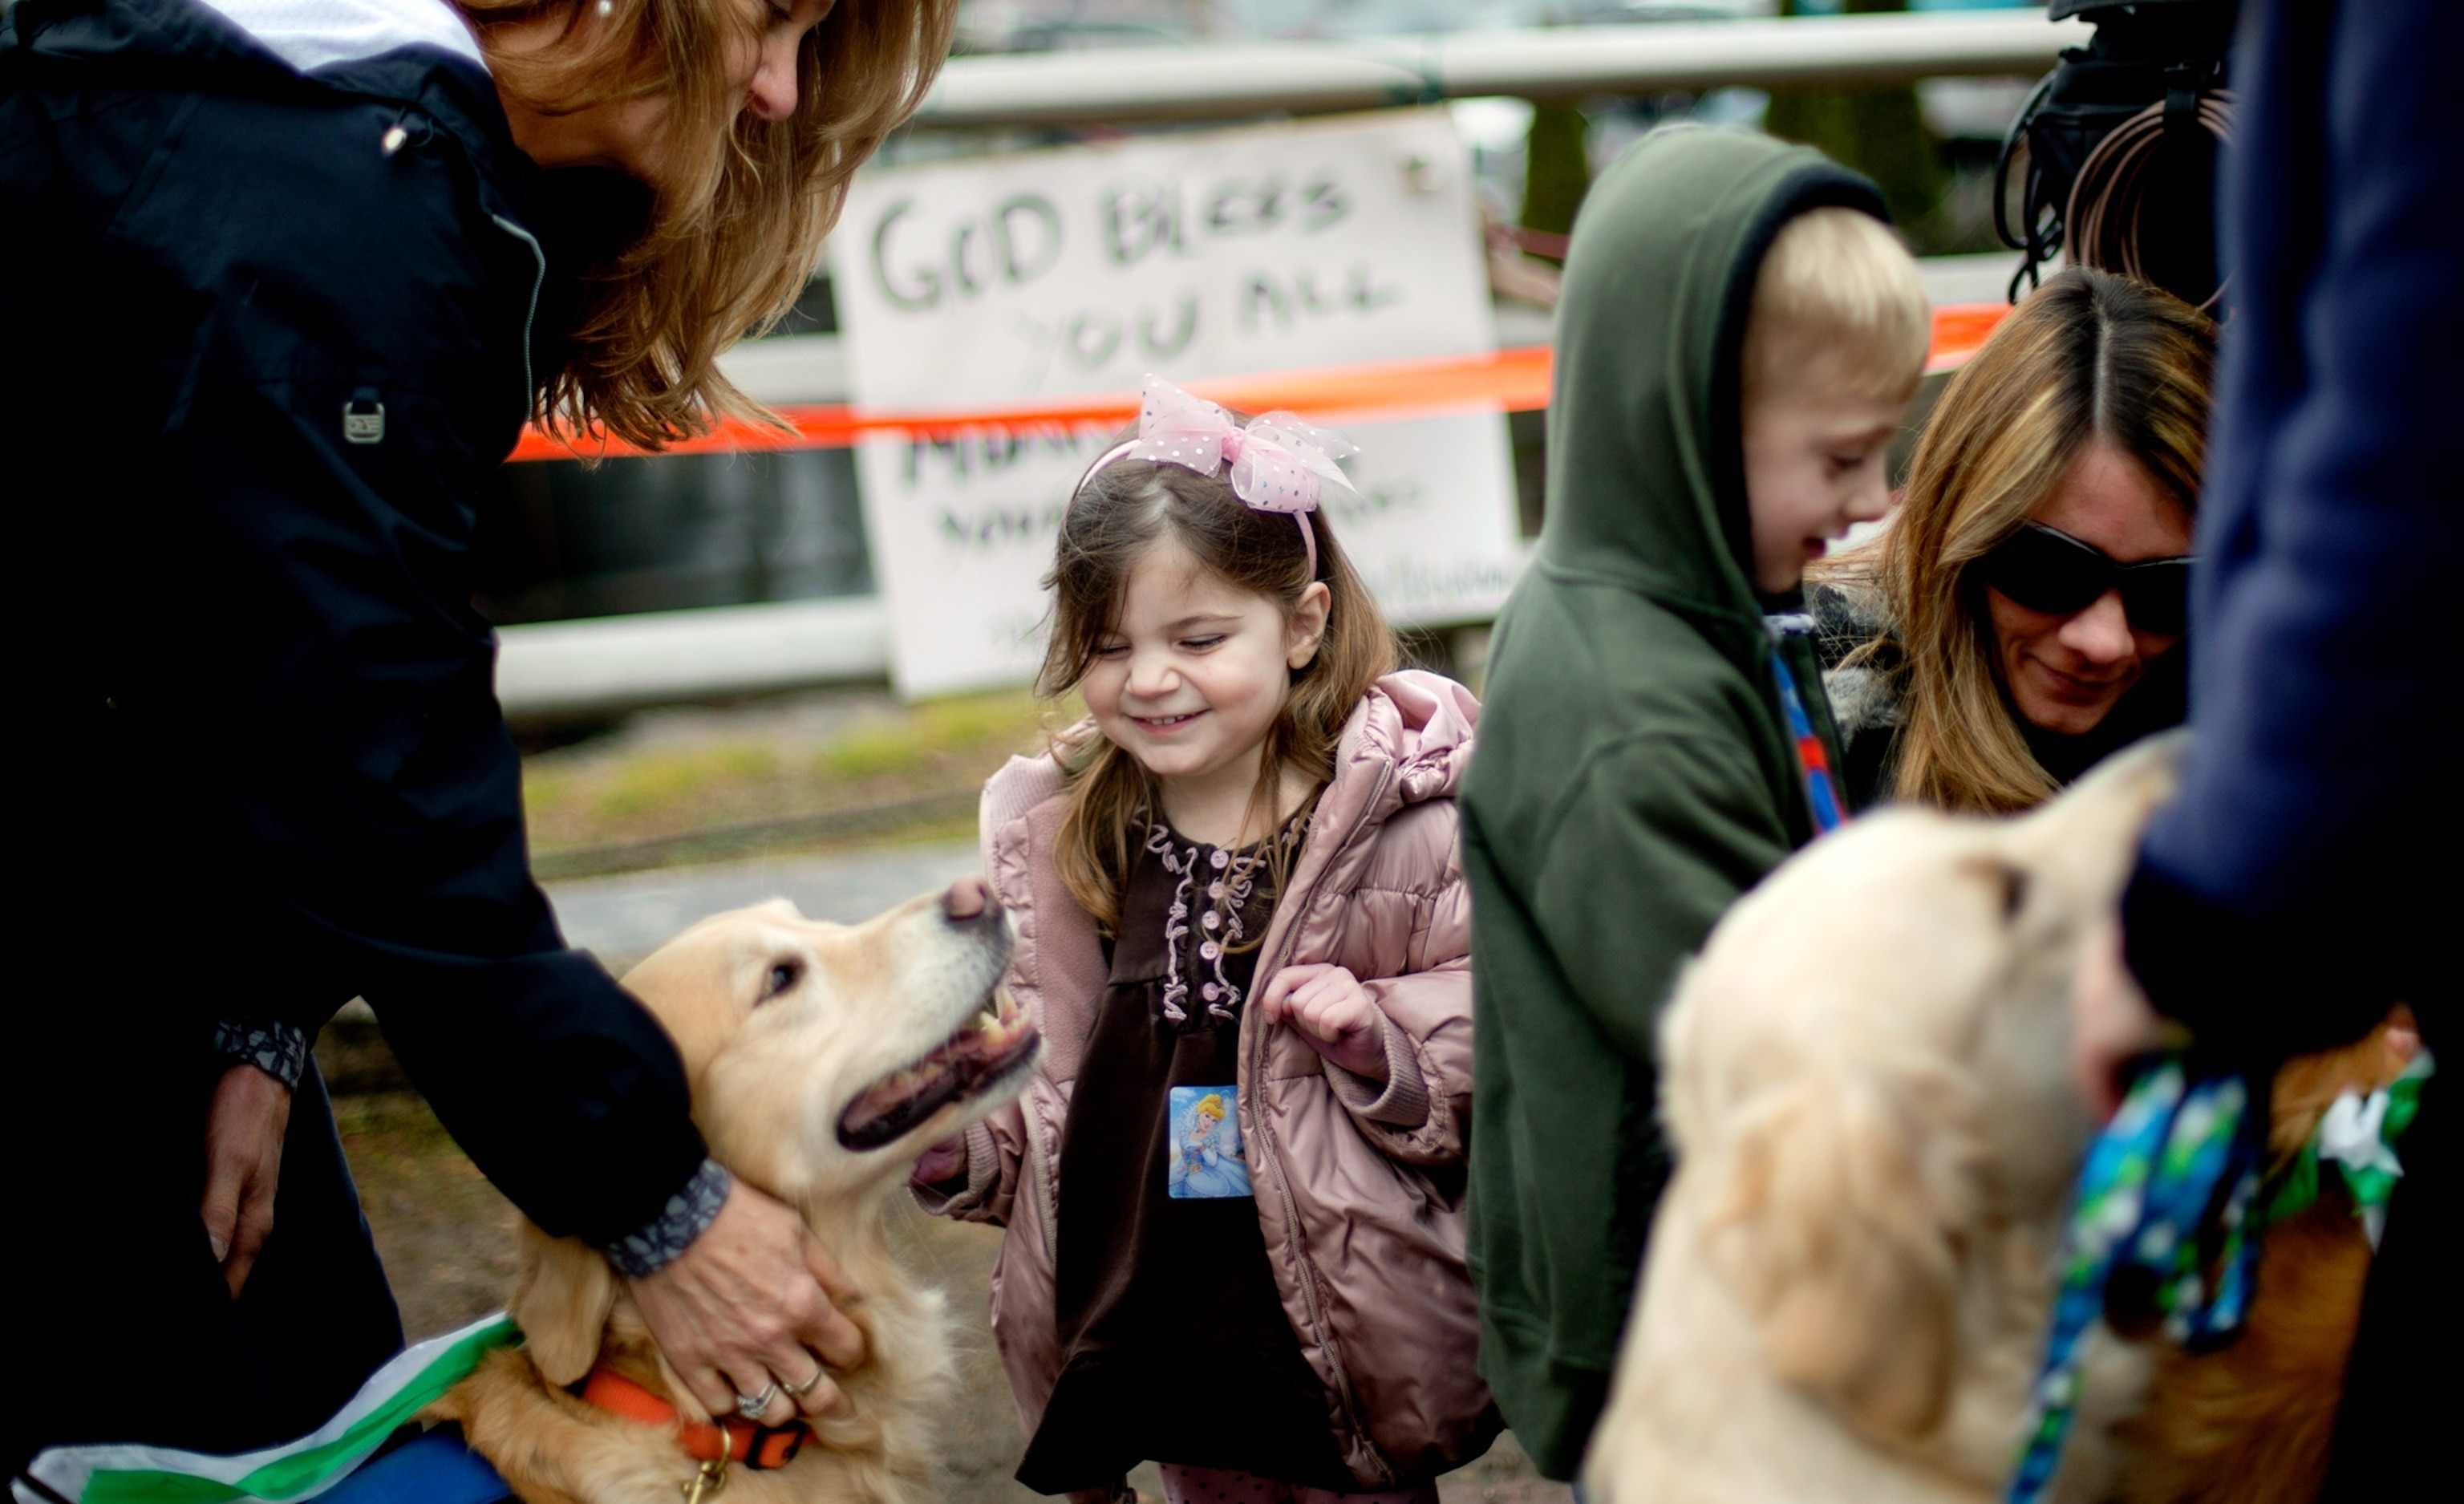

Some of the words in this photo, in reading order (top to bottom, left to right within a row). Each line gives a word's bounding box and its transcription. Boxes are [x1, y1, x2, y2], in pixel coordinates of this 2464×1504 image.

[869, 195, 1064, 313] GOD
[1009, 286, 1202, 391] YOU
[1238, 263, 1409, 334] ALL
